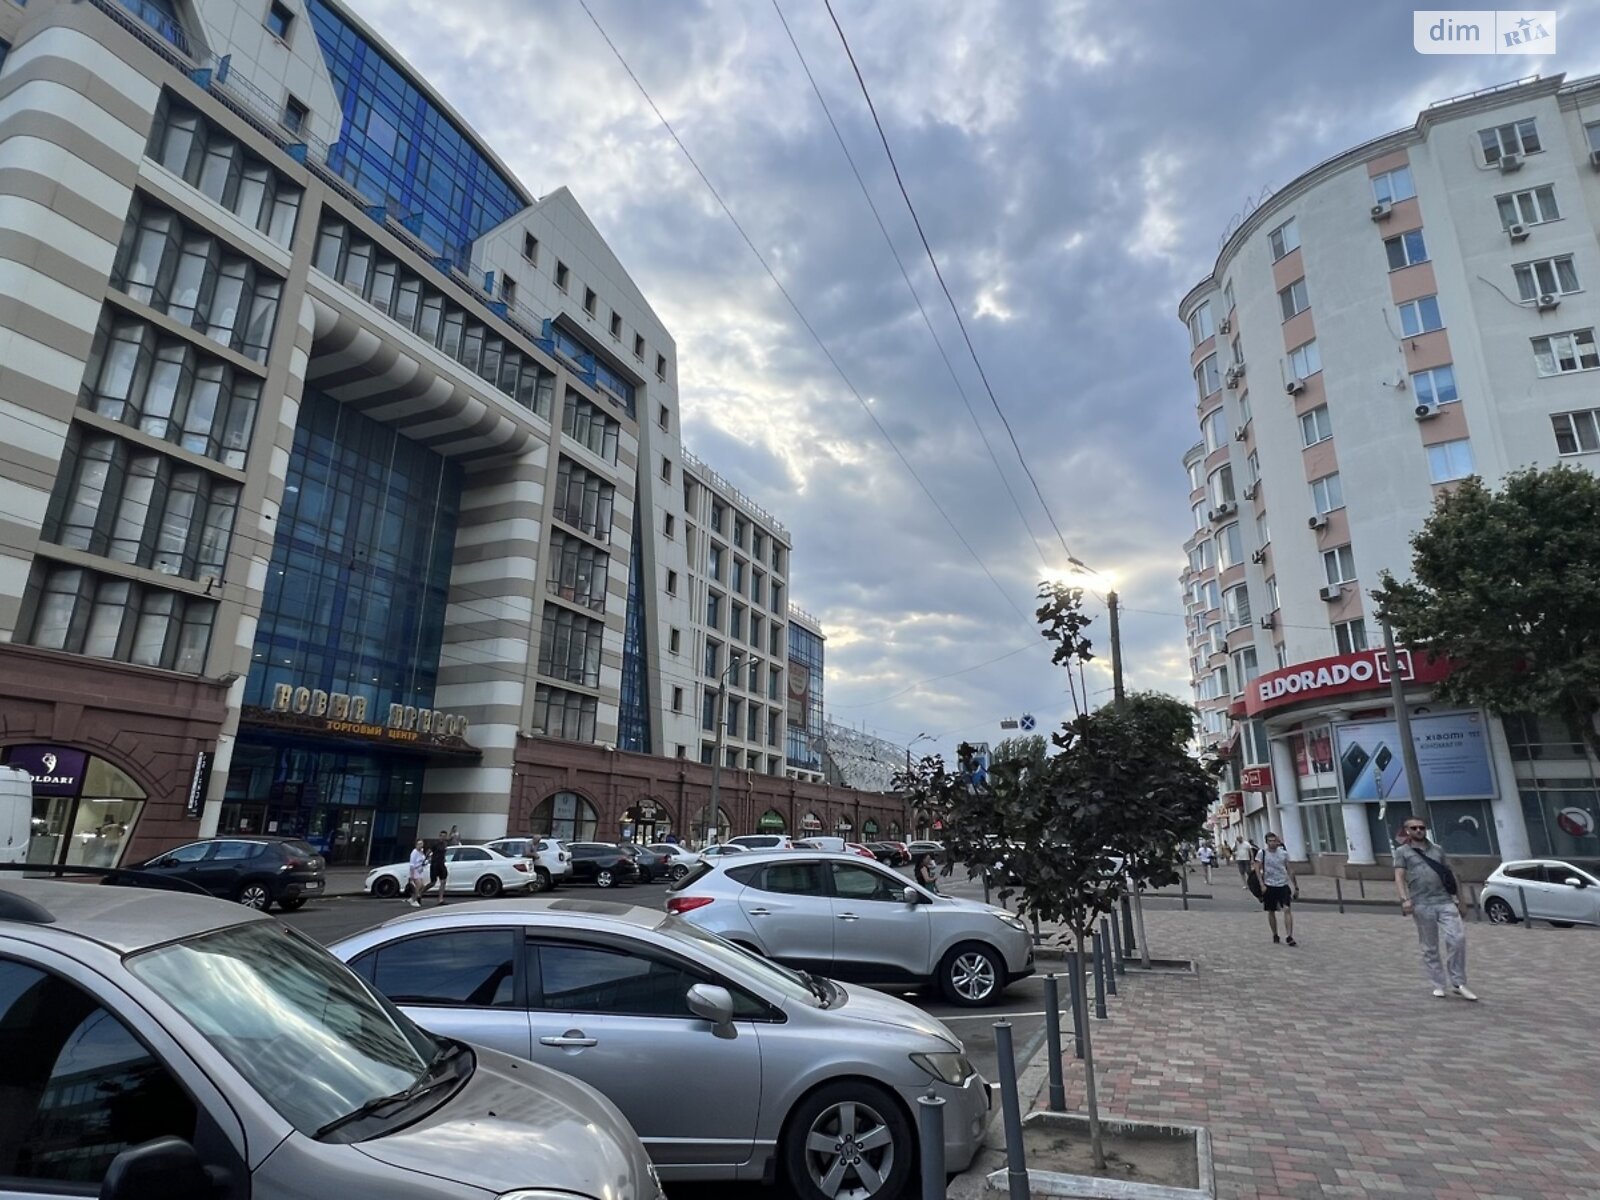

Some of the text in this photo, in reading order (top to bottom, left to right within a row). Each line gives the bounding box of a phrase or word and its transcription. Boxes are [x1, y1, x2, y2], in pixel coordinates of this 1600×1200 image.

[1259, 661, 1373, 701] ELDORADO
[326, 720, 418, 741] ТОРГОВЫЙ ЦЕНТР
